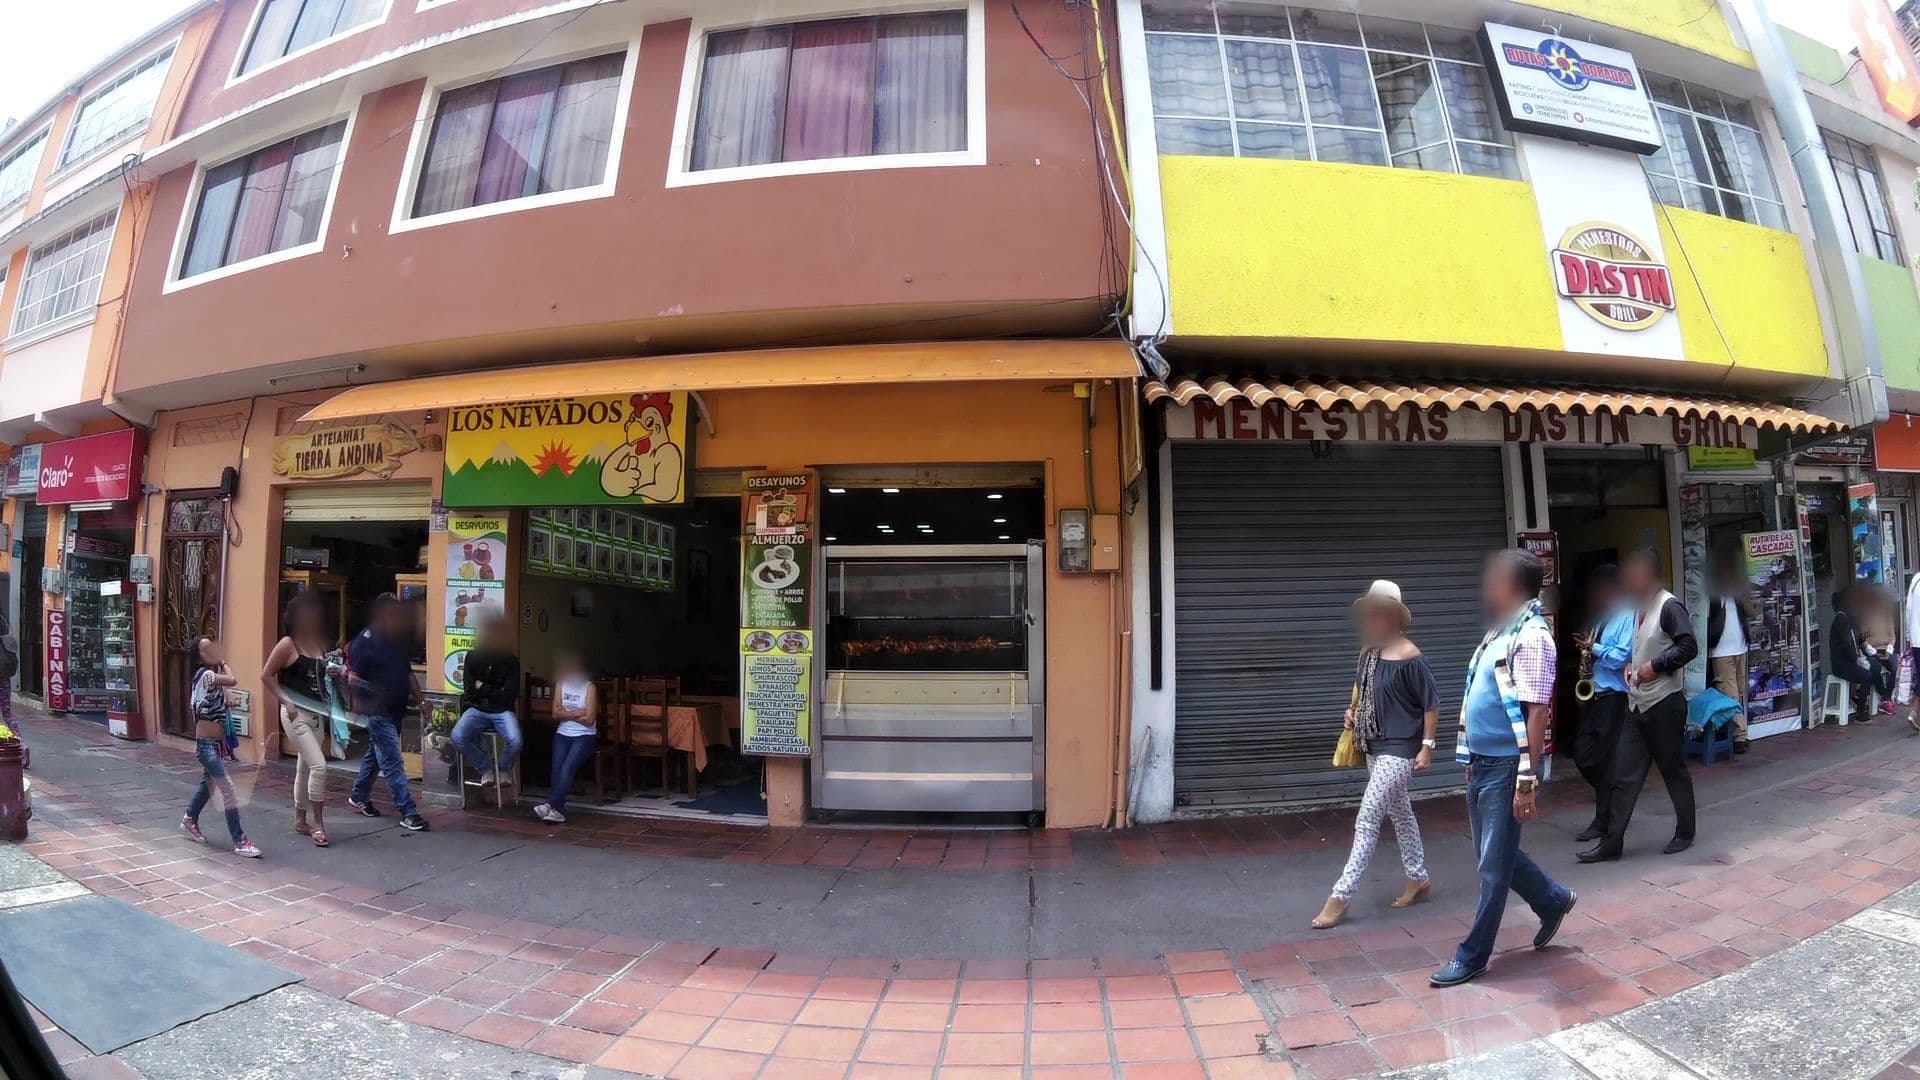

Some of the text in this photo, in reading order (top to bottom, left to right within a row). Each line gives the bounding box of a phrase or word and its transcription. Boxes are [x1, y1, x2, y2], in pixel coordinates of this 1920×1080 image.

[1505, 47, 1546, 68] RUTAS
[1580, 62, 1633, 87] DORADAS
[1576, 230, 1642, 258] MENESTRAS
[1560, 253, 1672, 306] DASTIN
[451, 408, 494, 432] LOS
[500, 400, 623, 429] NEVADOS
[1194, 400, 1449, 442] MENESTRAS
[1503, 409, 1747, 449] DASTIN GRILL
[311, 427, 365, 448] ARTESANIAS
[295, 442, 384, 472] TIERRA ANDINA
[41, 466, 68, 489] Claro
[749, 476, 806, 488] DESAYUNOS
[455, 520, 500, 530] DESAYUNOS
[751, 535, 805, 545] ALMUERZO
[1750, 535, 1769, 545] RUTA
[1750, 541, 1795, 554] CASCADAS
[50, 613, 64, 696] CABINAS
